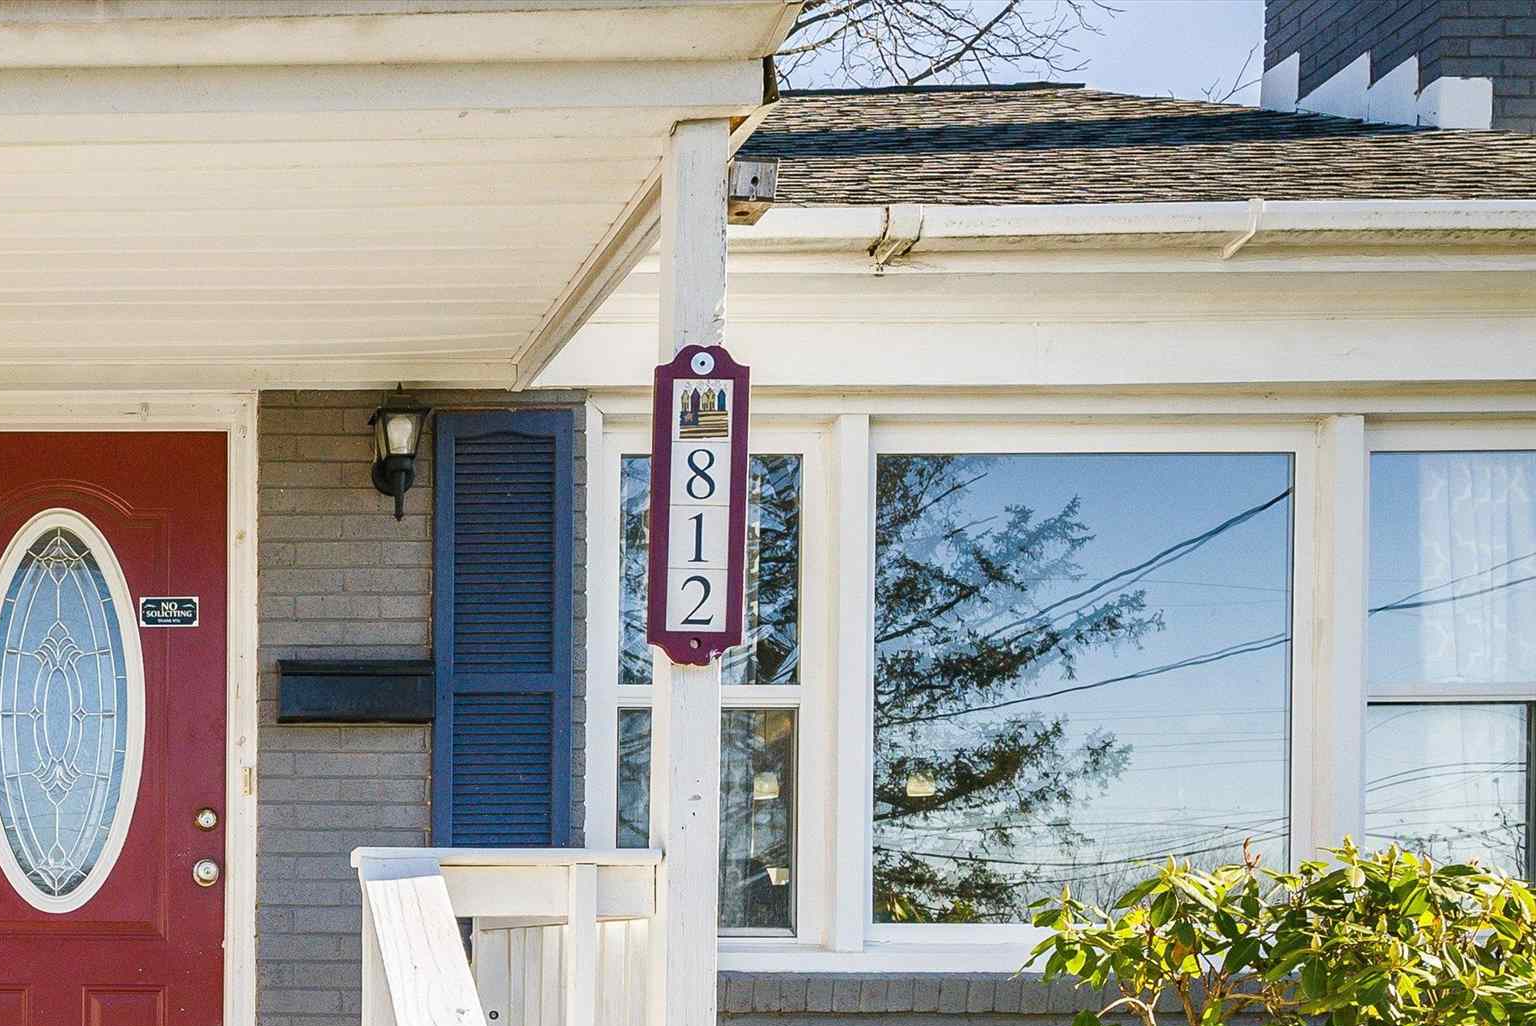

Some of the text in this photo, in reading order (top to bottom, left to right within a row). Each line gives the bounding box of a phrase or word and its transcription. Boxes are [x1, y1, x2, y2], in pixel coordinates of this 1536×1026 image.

[680, 448, 716, 625] 812
[161, 602, 178, 611] NO
[146, 609, 192, 618] SOLICITING
